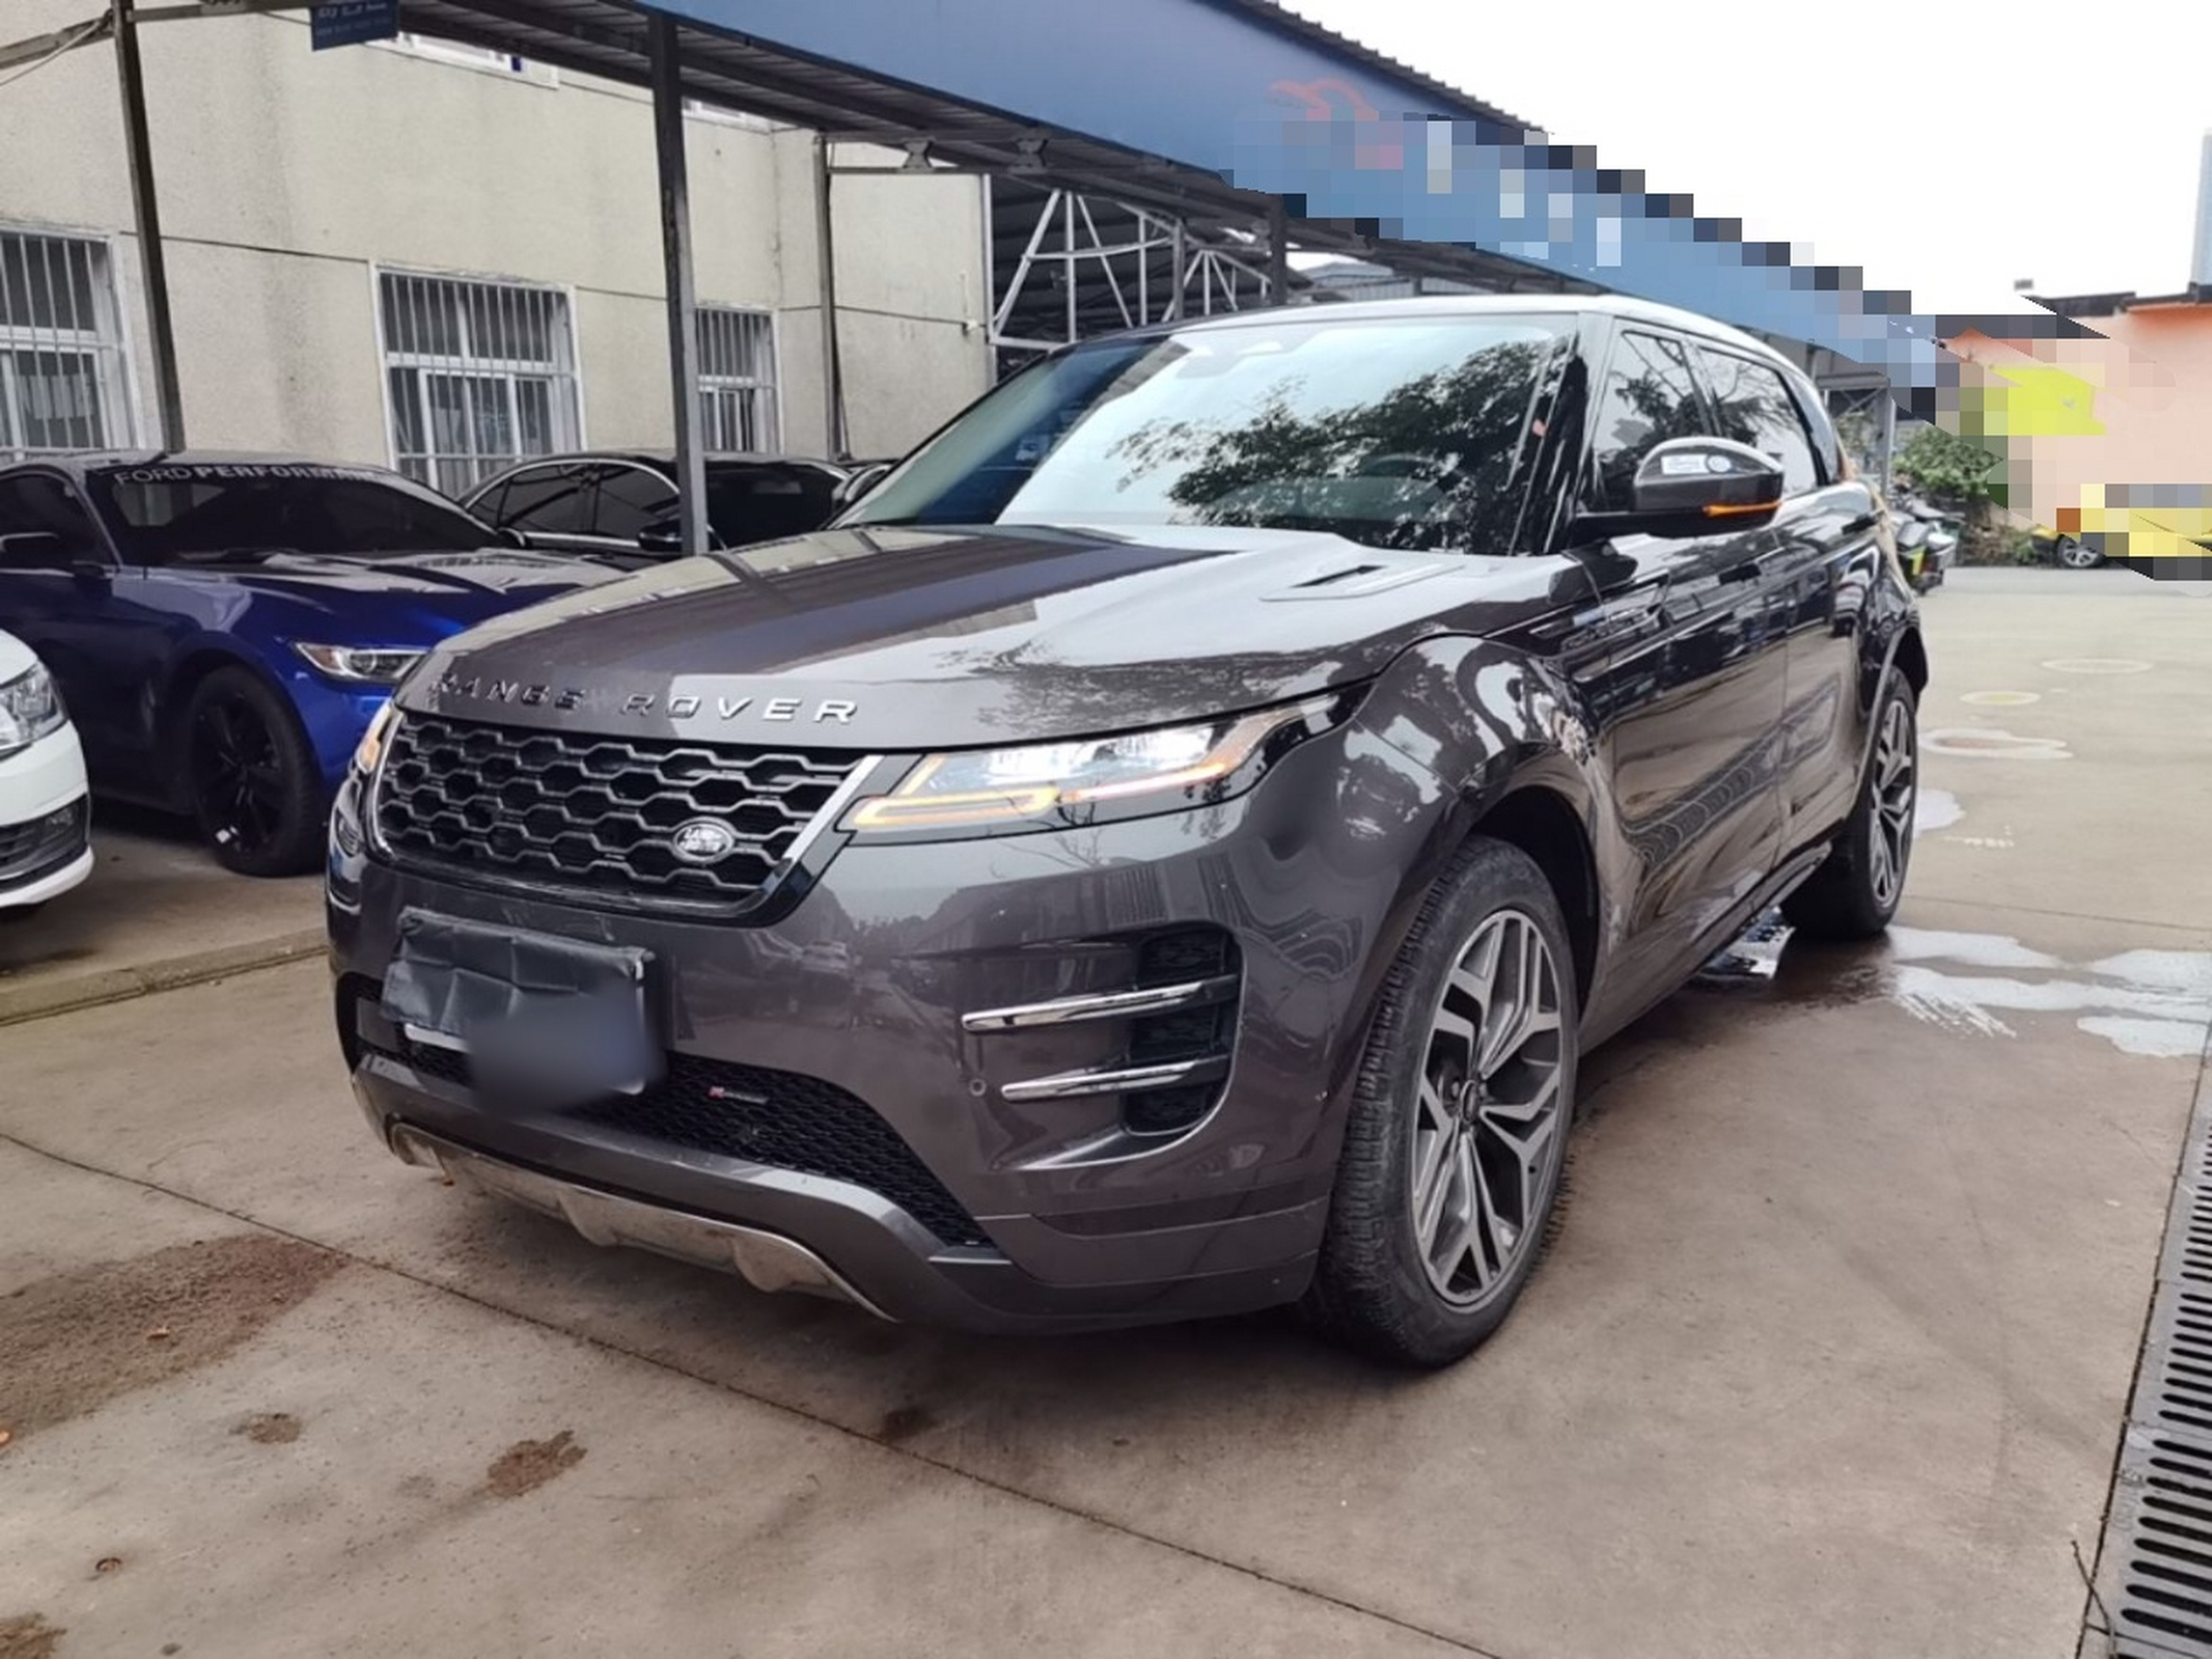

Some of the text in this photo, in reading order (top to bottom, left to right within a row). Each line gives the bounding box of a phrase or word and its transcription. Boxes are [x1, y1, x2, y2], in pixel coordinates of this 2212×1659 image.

[115, 465, 372, 485] FORD PERFORMAN
[620, 694, 857, 724] ROVER
